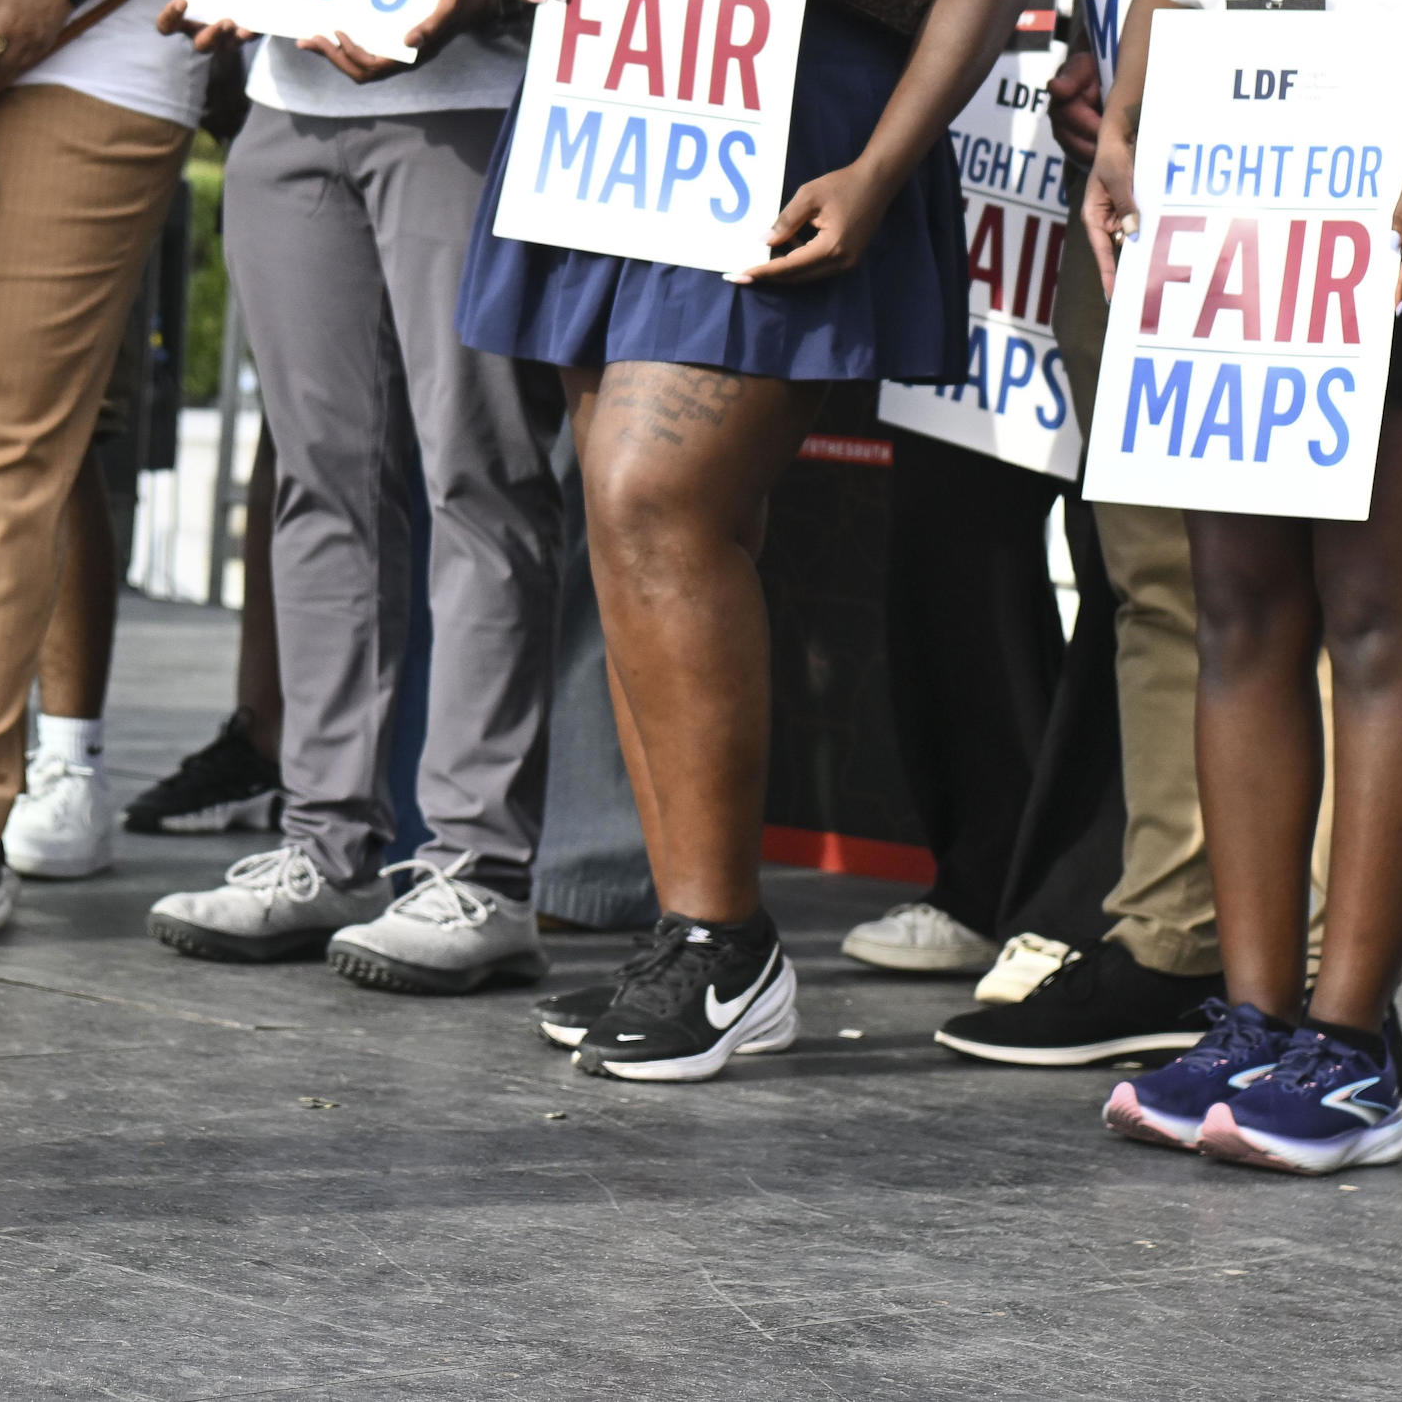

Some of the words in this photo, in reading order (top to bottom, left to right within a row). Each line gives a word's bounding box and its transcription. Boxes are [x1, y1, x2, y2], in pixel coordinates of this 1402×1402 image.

[997, 78, 1045, 113] LDF
[1232, 69, 1298, 100] LDF
[534, 105, 757, 224] MAPS
[1165, 144, 1288, 197] FIGHT
[1304, 147, 1381, 199] FOR
[964, 204, 1067, 327] AI
[1139, 214, 1371, 345] FAIR
[1120, 357, 1357, 468] MAPS
